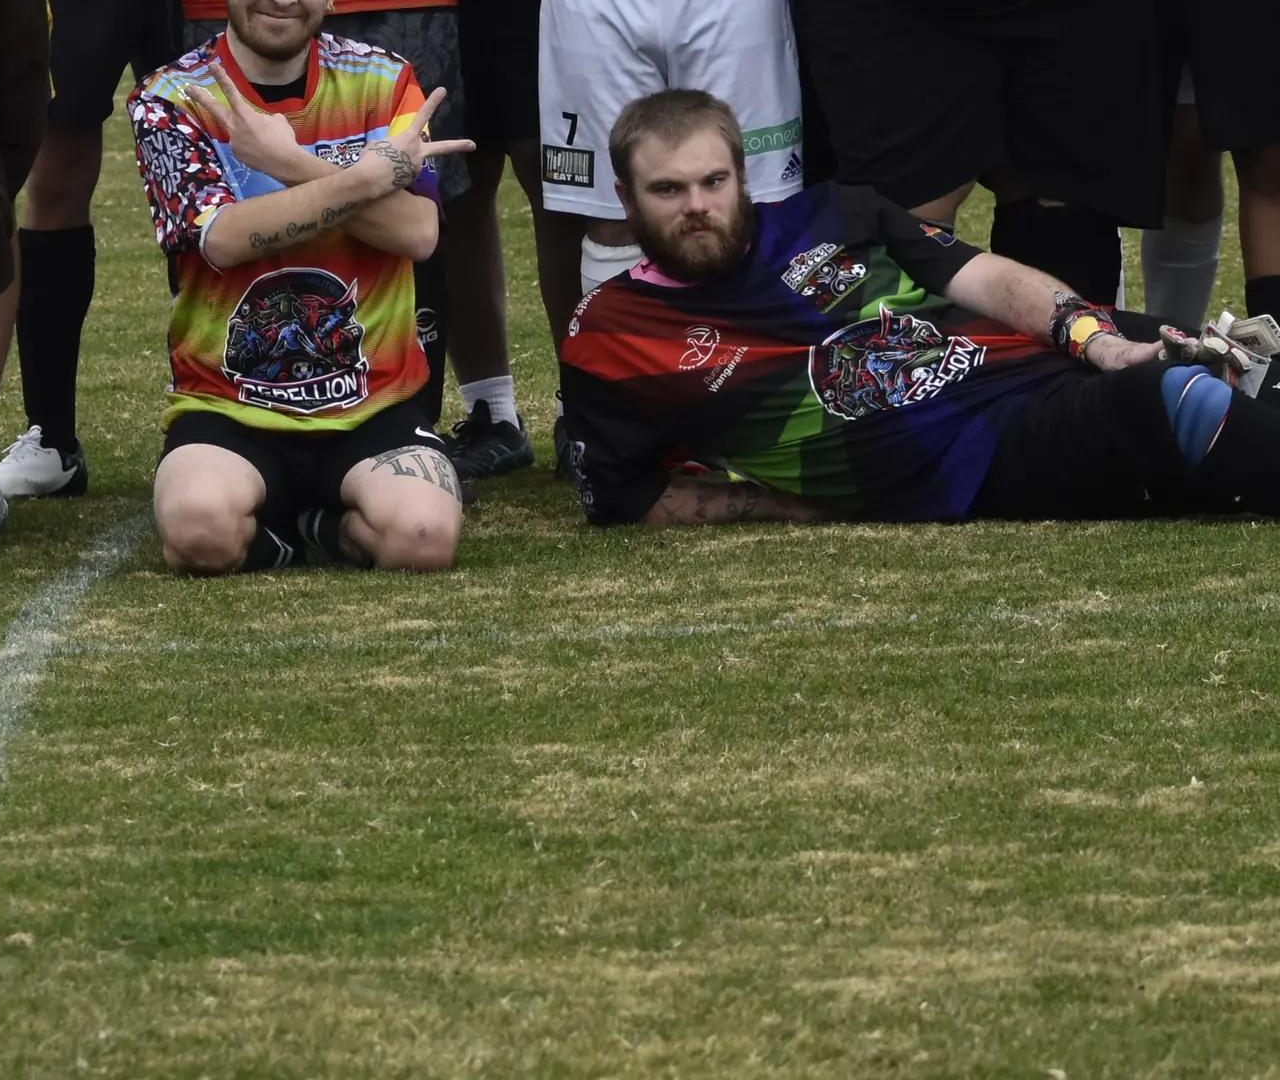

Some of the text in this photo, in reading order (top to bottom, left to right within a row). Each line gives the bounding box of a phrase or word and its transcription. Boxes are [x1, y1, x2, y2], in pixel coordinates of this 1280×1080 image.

[562, 111, 578, 146] 7
[151, 149, 187, 181] GIVE
[574, 175, 589, 184] ME
[162, 172, 181, 199] UP
[708, 346, 749, 393] Wangaratta
